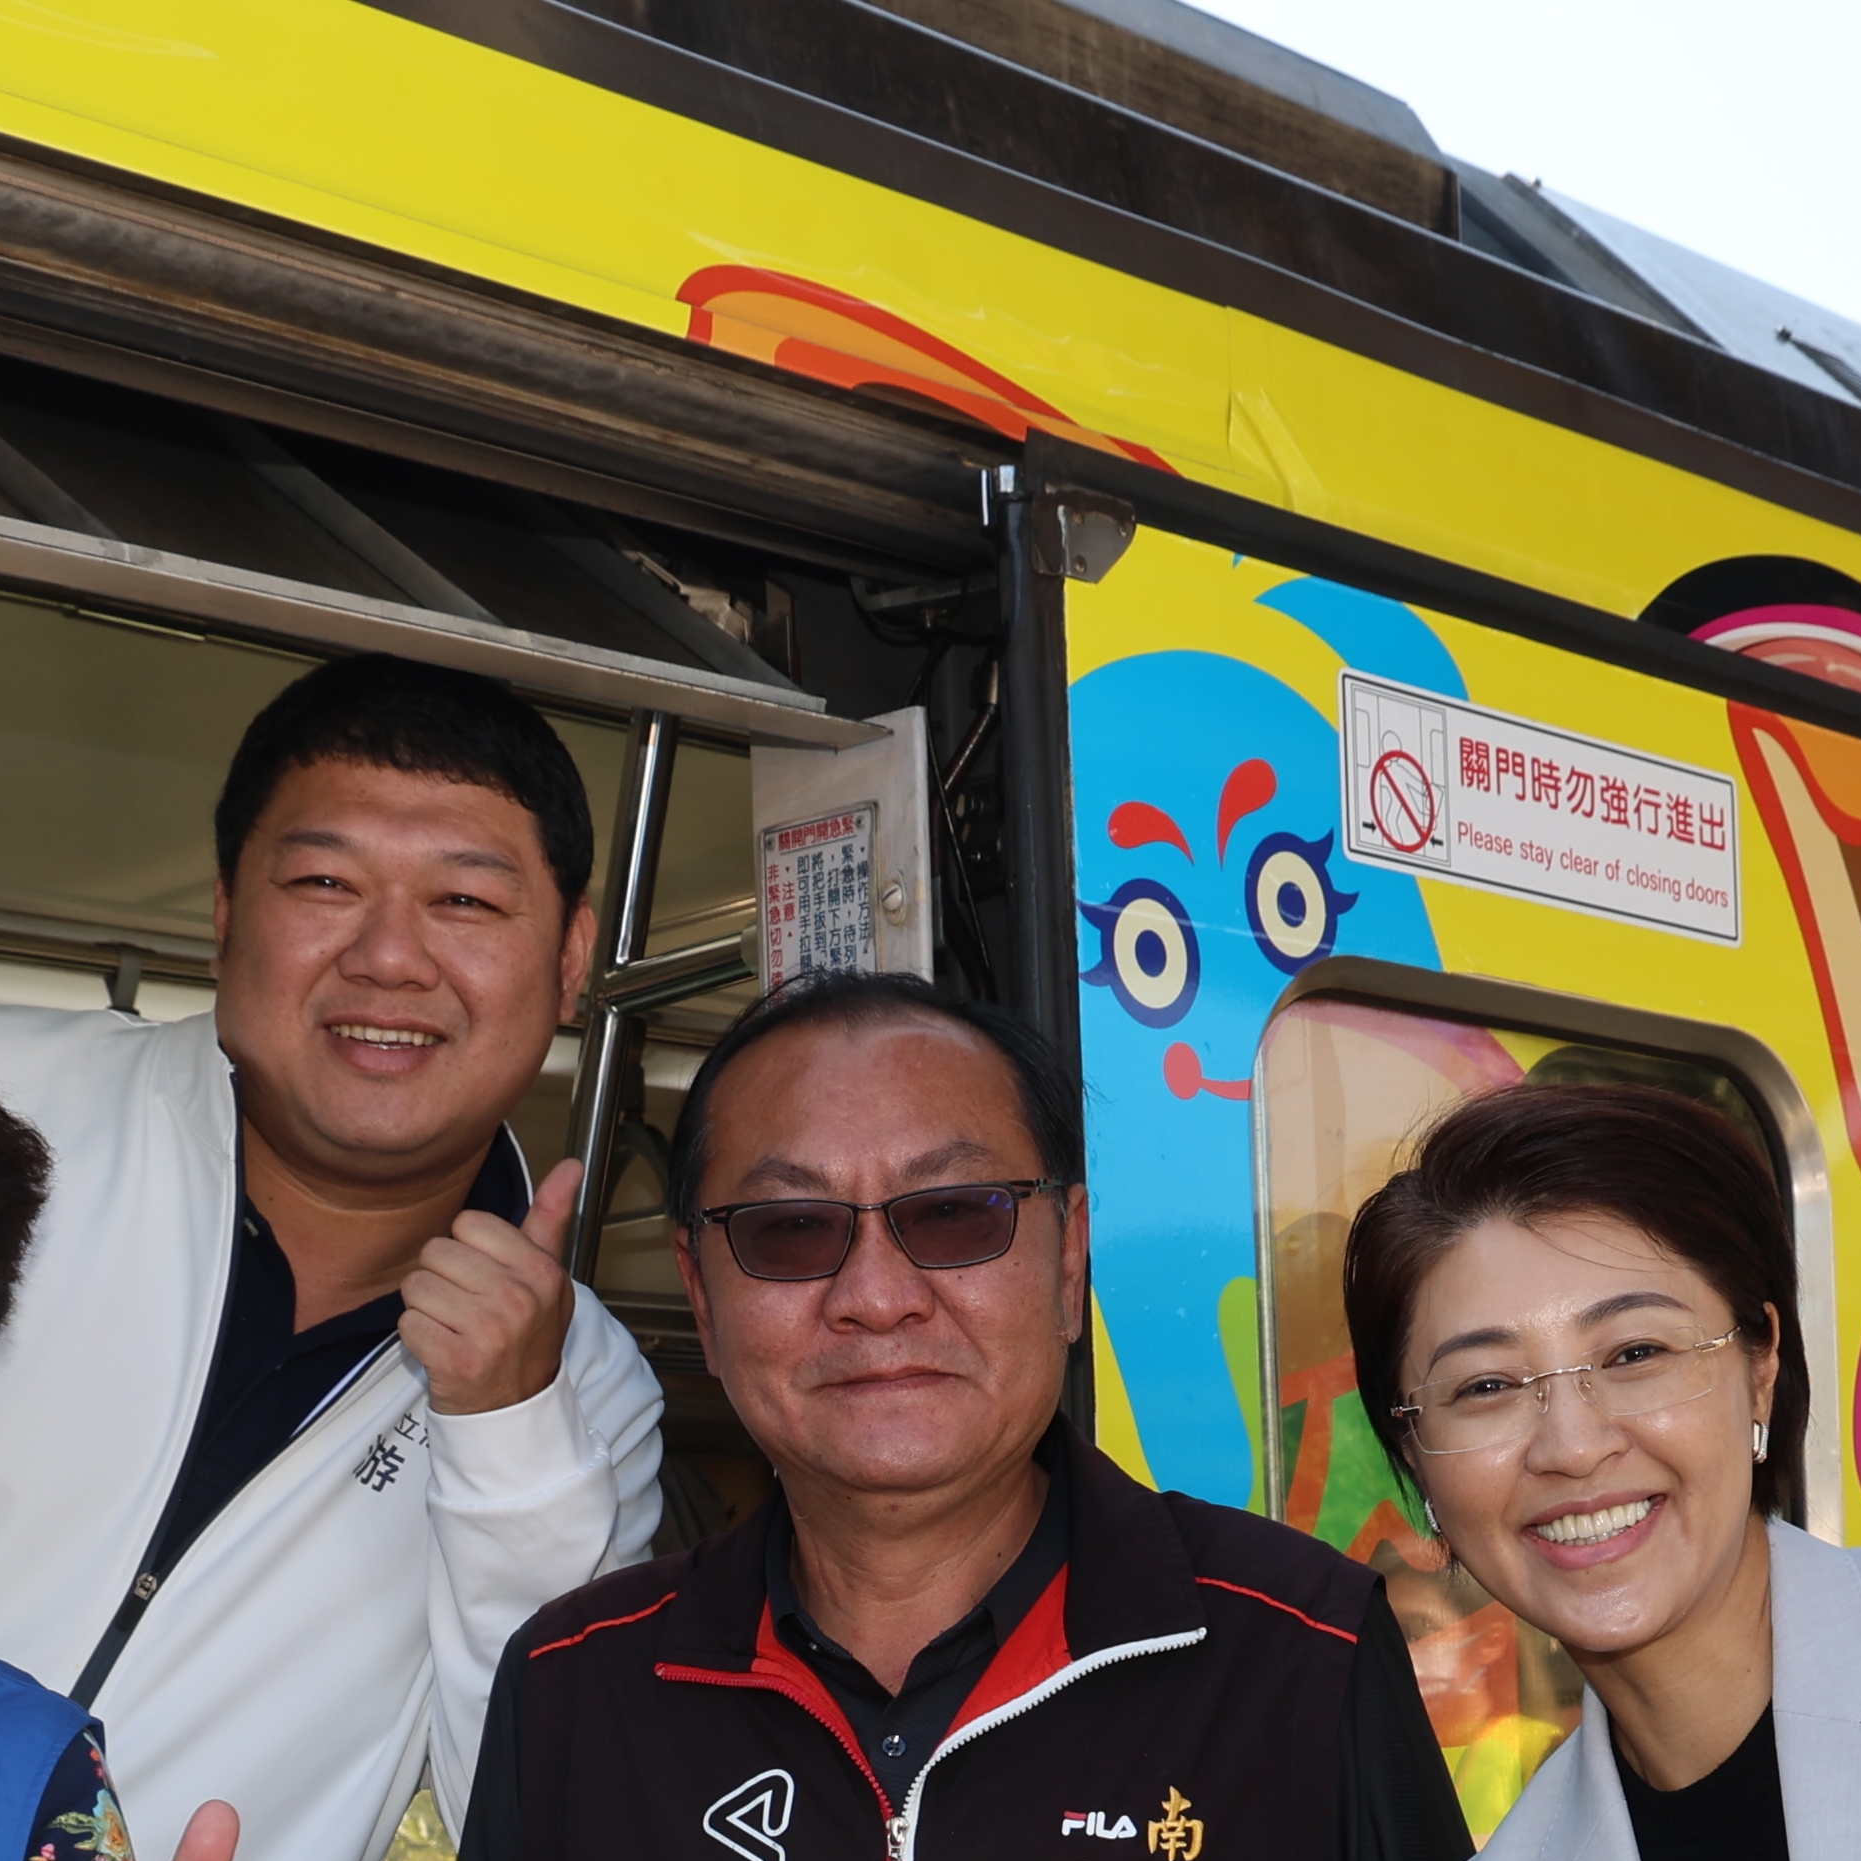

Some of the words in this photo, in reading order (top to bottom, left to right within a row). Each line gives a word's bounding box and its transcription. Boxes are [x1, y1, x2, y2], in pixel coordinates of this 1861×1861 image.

[1459, 736, 1727, 852] 關門時勿強行進出
[1458, 821, 1513, 855] Please
[1520, 836, 1553, 871] stay
[1560, 847, 1598, 877] clear
[1605, 859, 1621, 882] of
[1627, 864, 1682, 901] closing
[1686, 877, 1729, 909] doors
[1061, 1811, 1138, 1840] FILA
